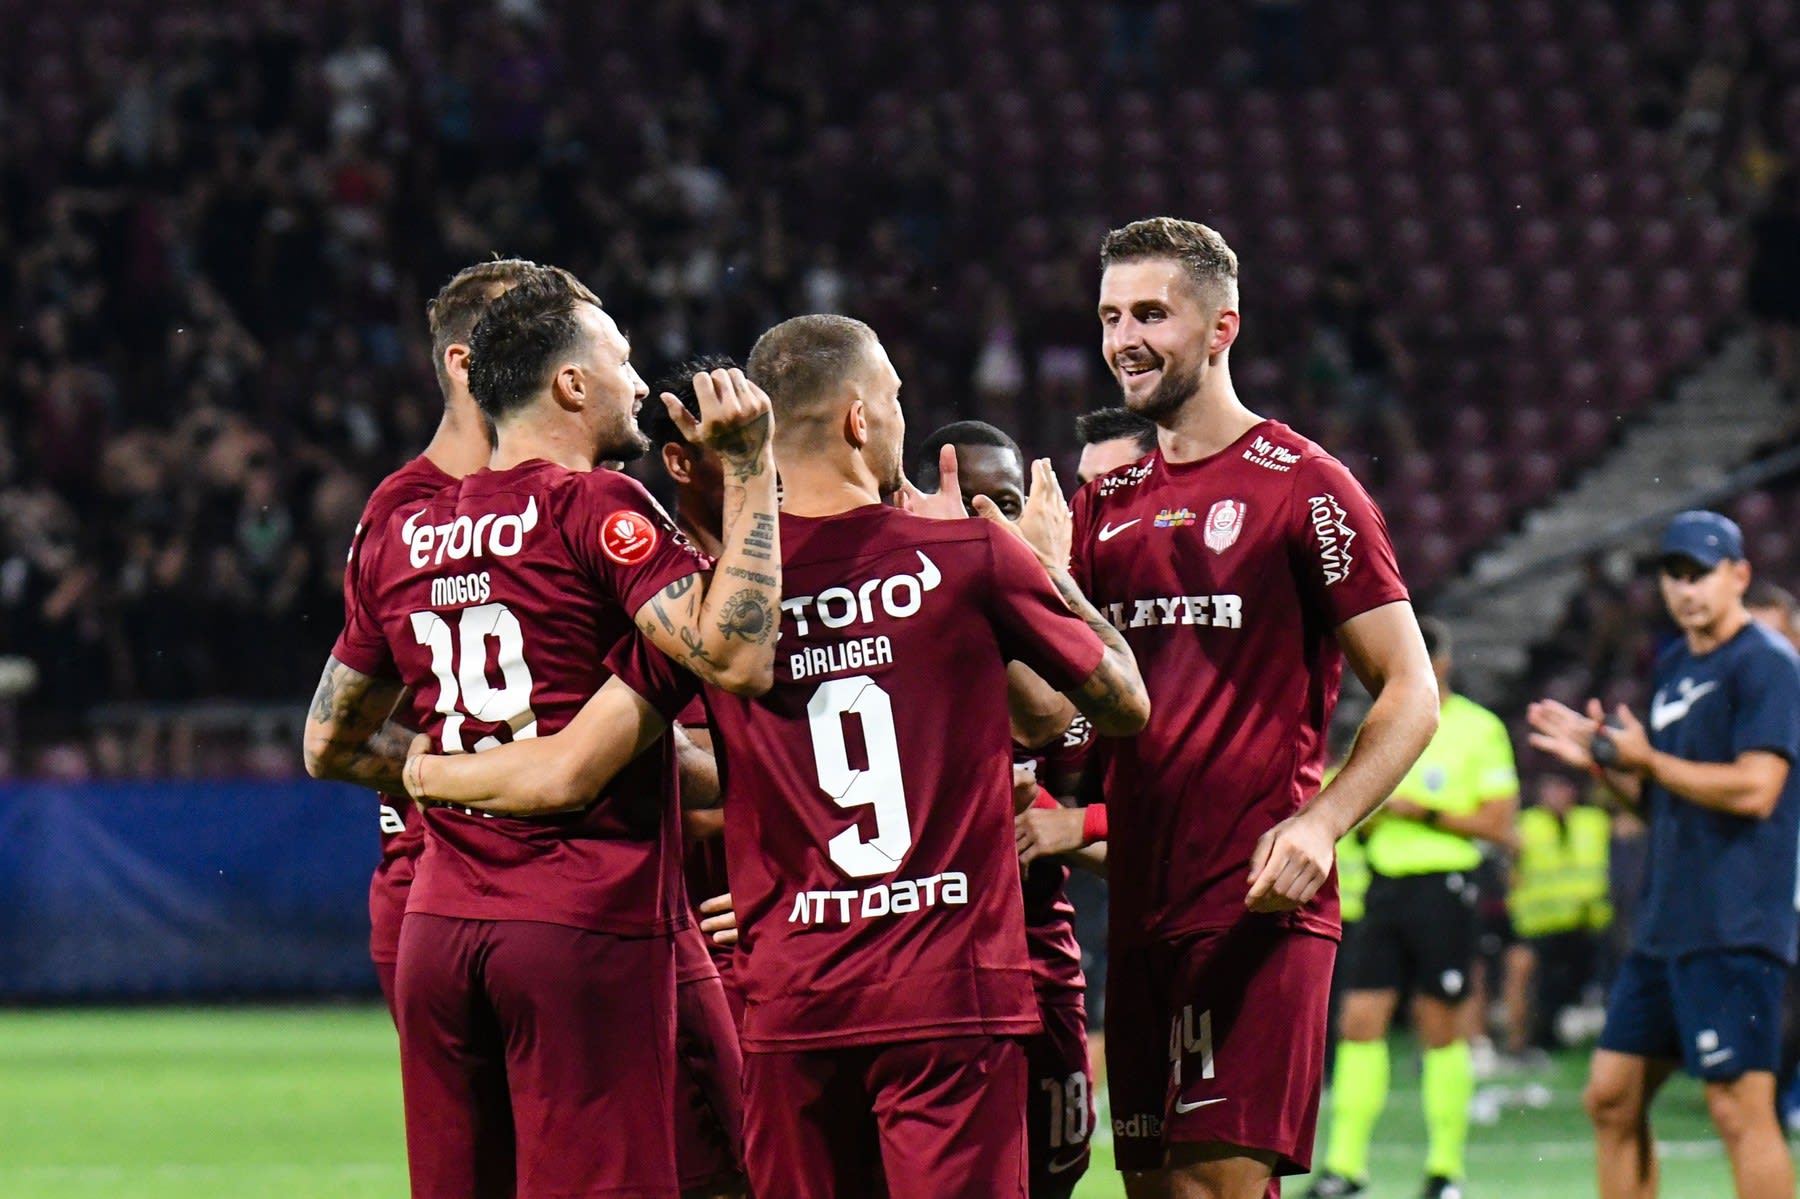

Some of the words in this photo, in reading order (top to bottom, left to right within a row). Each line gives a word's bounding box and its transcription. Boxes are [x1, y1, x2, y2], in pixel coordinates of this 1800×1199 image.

[1250, 436, 1273, 457] My
[1308, 496, 1342, 586] AQUAVIA
[1100, 594, 1242, 631] LAYER
[410, 602, 538, 754] 19
[790, 636, 893, 680] BÎRLIGEA
[807, 675, 912, 878] 9
[788, 891, 859, 925] NTT
[1041, 1071, 1089, 1148] 18
